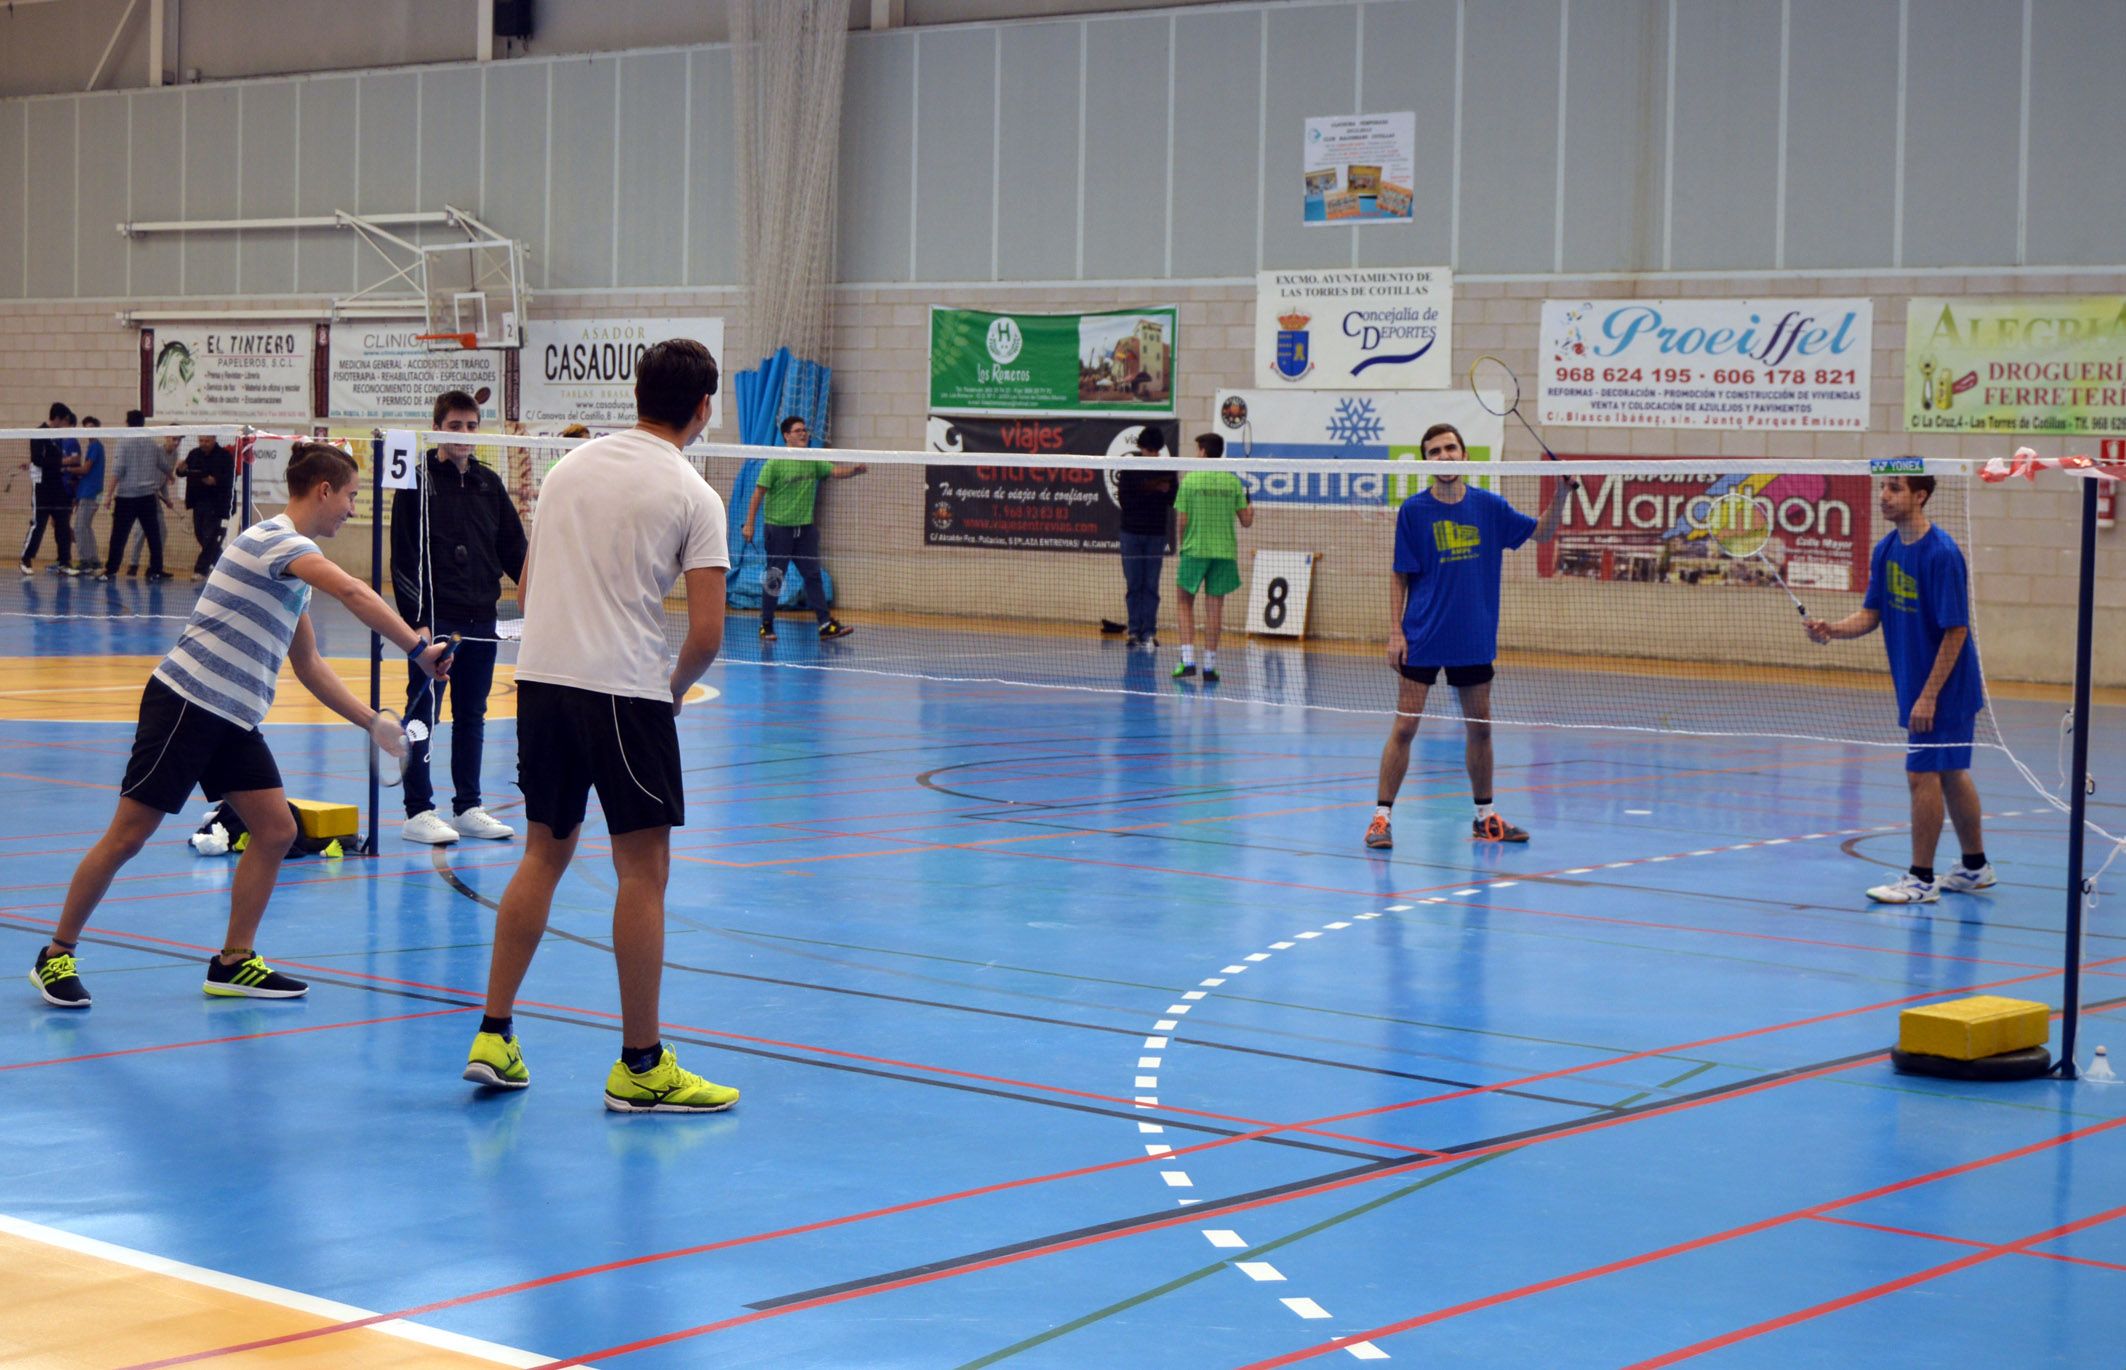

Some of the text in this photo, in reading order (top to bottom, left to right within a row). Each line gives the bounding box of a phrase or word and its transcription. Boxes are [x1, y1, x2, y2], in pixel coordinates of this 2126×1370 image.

[1276, 272, 1433, 286] EXCMO. AYUNTAMIENTO DE
[1281, 286, 1429, 298] LAS TORRES DE COTILLAS
[1342, 307, 1439, 337] Concejalía de
[508, 324, 513, 337] 2
[582, 327, 646, 339] ASADOR
[1593, 305, 1857, 367] Proeiffel
[207, 334, 295, 354] EL TINTERO
[1361, 326, 1437, 350] DEPORTES
[339, 358, 490, 370] MEDICINA GENERAL ACCIDENTES DE TRÁFICO
[545, 343, 647, 381] CASADUQ
[333, 372, 376, 382] FISIOTERAPIA
[440, 372, 496, 382] ESPECIALIDADES
[977, 363, 1031, 383] Los Romeros
[1556, 368, 1857, 385] 968 624 195 606 178 821
[1988, 358, 2126, 382] DROGUERÍ
[352, 384, 412, 394] RECONOCIMIENTO
[414, 384, 422, 394] DE
[1548, 388, 1593, 396] REFORMAS
[1797, 391, 1808, 399] DE
[1812, 391, 1861, 400] VIVIENDAS
[376, 396, 380, 405] Y
[382, 396, 413, 406] PERMISO
[414, 396, 422, 406] DE
[576, 400, 636, 410] www.casaduque.
[1591, 401, 1618, 410] VENTA
[1620, 401, 1626, 410] Y
[1685, 402, 1696, 410] DE
[1698, 403, 1743, 412] AZULEJOS
[1746, 404, 1751, 412] Y
[1753, 404, 1812, 413] PAVIMENTOS
[526, 411, 535, 420] C/
[568, 410, 578, 420] del
[618, 412, 638, 420] Murc
[1704, 415, 1743, 426] Junto
[1748, 416, 1796, 428] Parque
[1802, 416, 1861, 426] Emisora
[1922, 415, 1933, 428] La
[1970, 416, 1986, 428] Las
[1988, 416, 2016, 429] Torres
[2019, 416, 2030, 429] de
[2032, 416, 2066, 429] Cotillas
[1000, 422, 1064, 453] viajes
[391, 449, 408, 479] 5
[1890, 460, 1921, 471] YONEX
[939, 482, 1099, 504] Tu agencia de viajes de confianza
[1562, 474, 1851, 536] Marathon
[1264, 577, 1288, 629] 8
